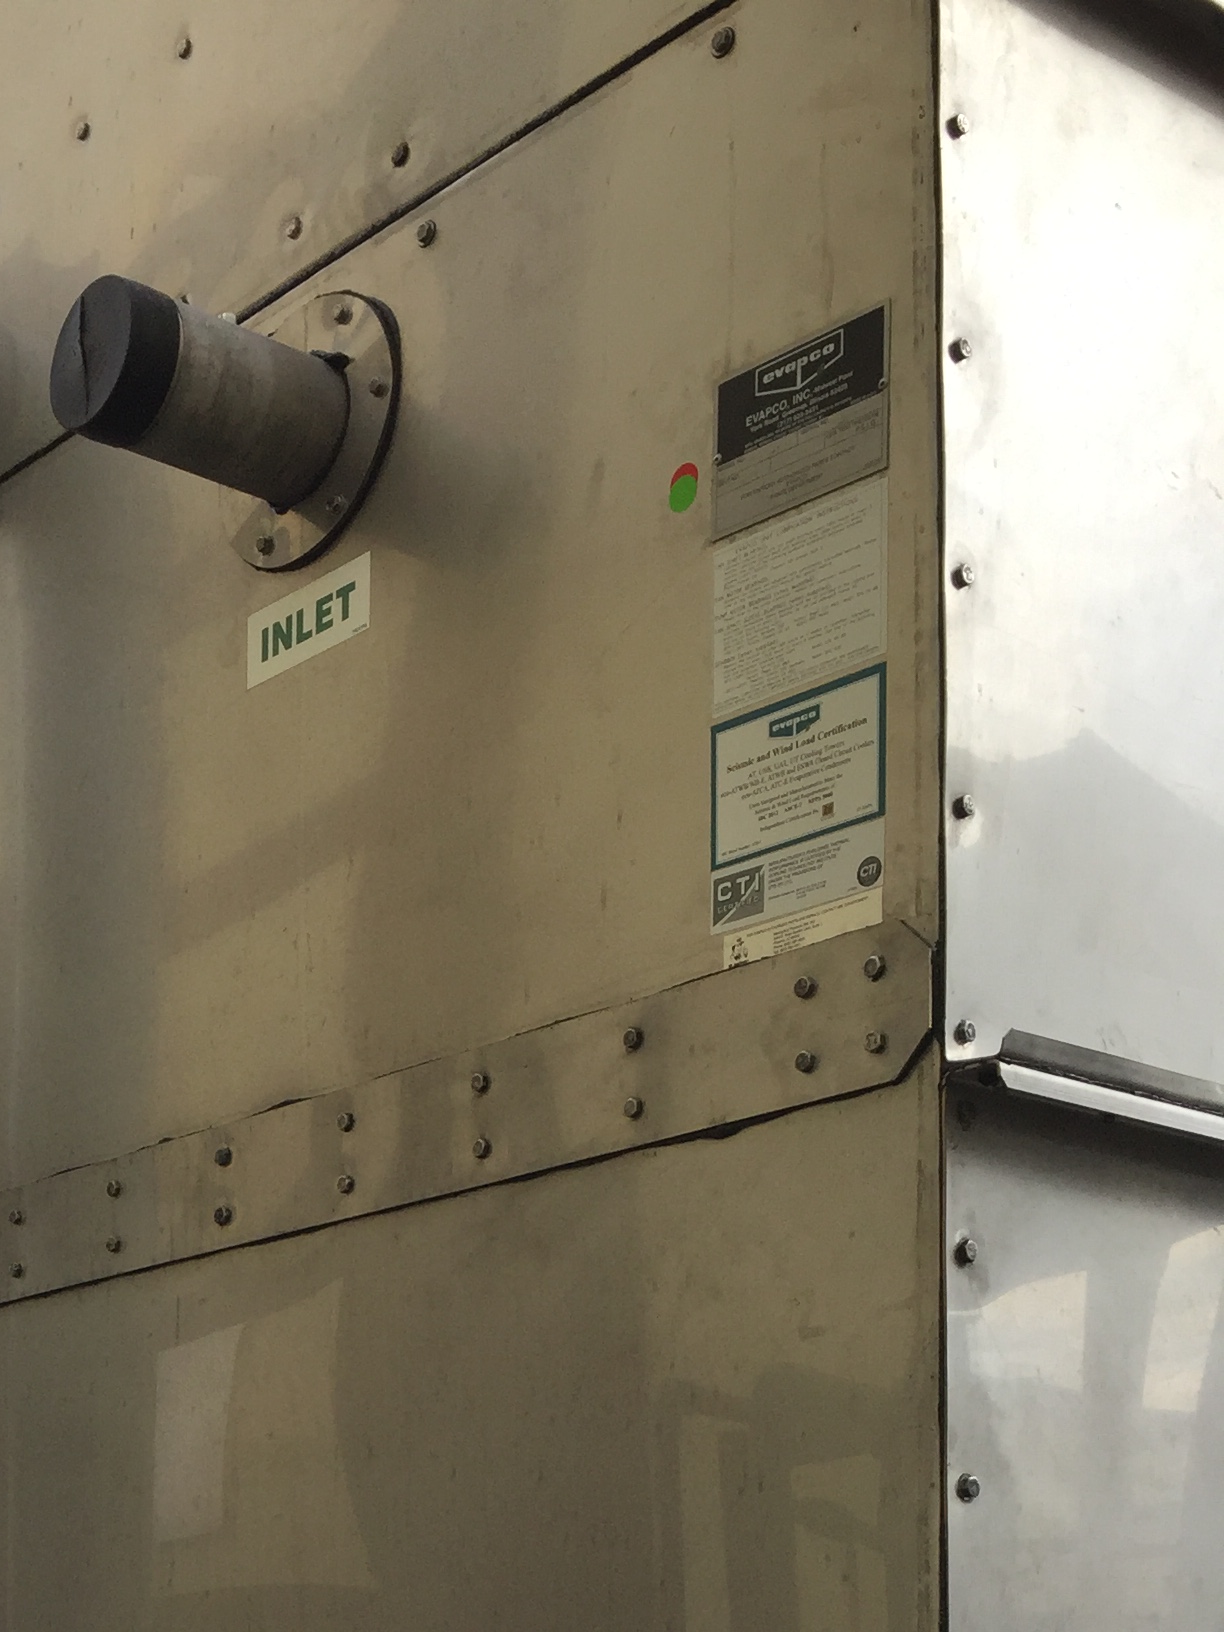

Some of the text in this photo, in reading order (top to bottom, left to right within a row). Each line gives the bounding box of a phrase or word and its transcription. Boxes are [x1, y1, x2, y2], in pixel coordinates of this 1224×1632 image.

[762, 343, 834, 384] evapco
[745, 397, 789, 426] EVAPCO,
[792, 387, 812, 404] INC.
[261, 581, 356, 663] INLET
[772, 711, 816, 731] evapco
[726, 718, 867, 773] Seismic and Wind Load Certification
[717, 872, 759, 902] CTI
[859, 863, 876, 877] CTI
